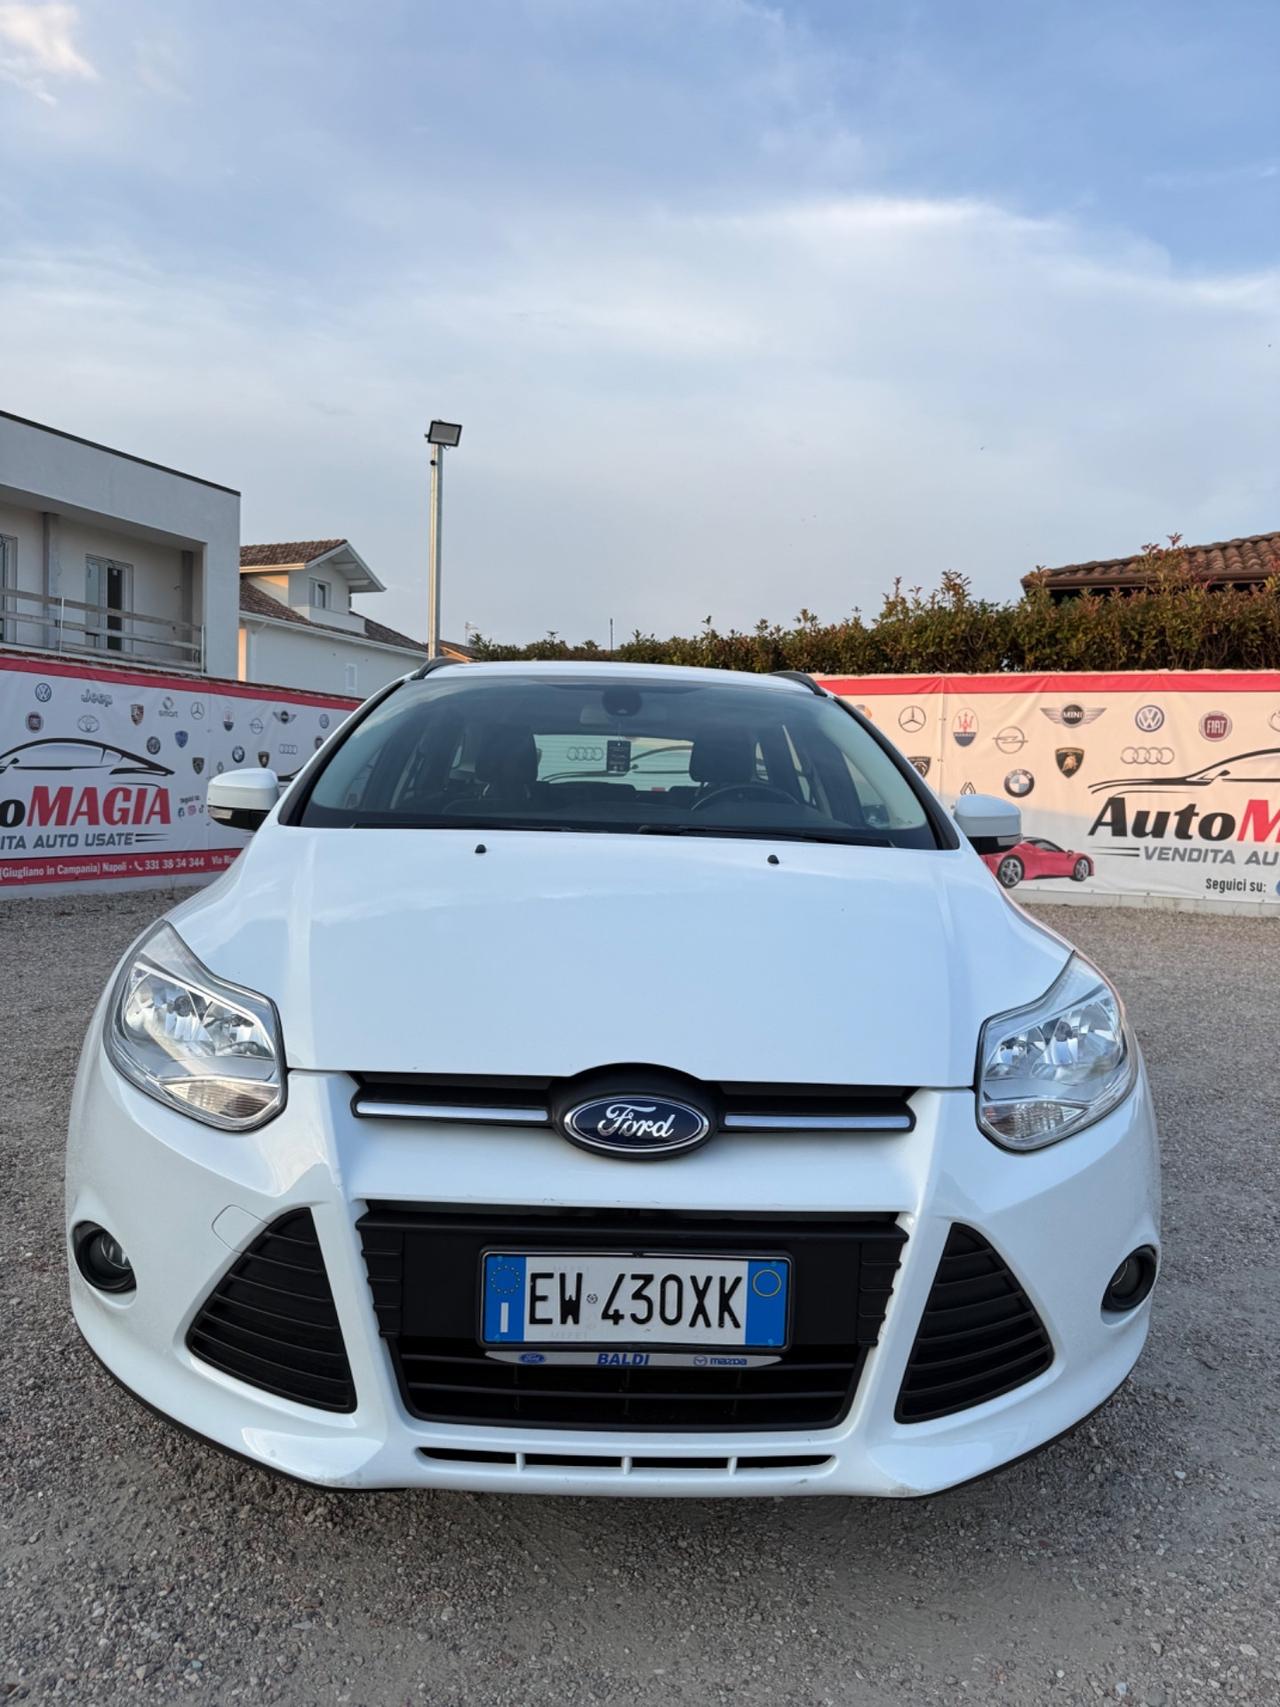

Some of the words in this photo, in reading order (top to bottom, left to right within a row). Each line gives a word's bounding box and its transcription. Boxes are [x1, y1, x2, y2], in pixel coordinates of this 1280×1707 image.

[81, 689, 113, 707] Jeep
[1206, 719, 1226, 734] FIAT
[1088, 797, 1280, 842] AutoM
[33, 834, 79, 849] AUTO
[85, 832, 134, 846] USATE
[1144, 846, 1236, 864] VENDITA
[47, 865, 54, 875] in
[57, 862, 100, 875] Campania)
[103, 861, 127, 873] Napoli
[145, 860, 159, 870] 331
[189, 857, 205, 867] 344
[1205, 878, 1247, 893] Seguici
[1250, 883, 1267, 893] su:
[597, 1103, 676, 1138] Ford
[528, 1272, 583, 1326] EW
[601, 1273, 743, 1329] 430XK
[597, 1353, 649, 1366] BALDI
